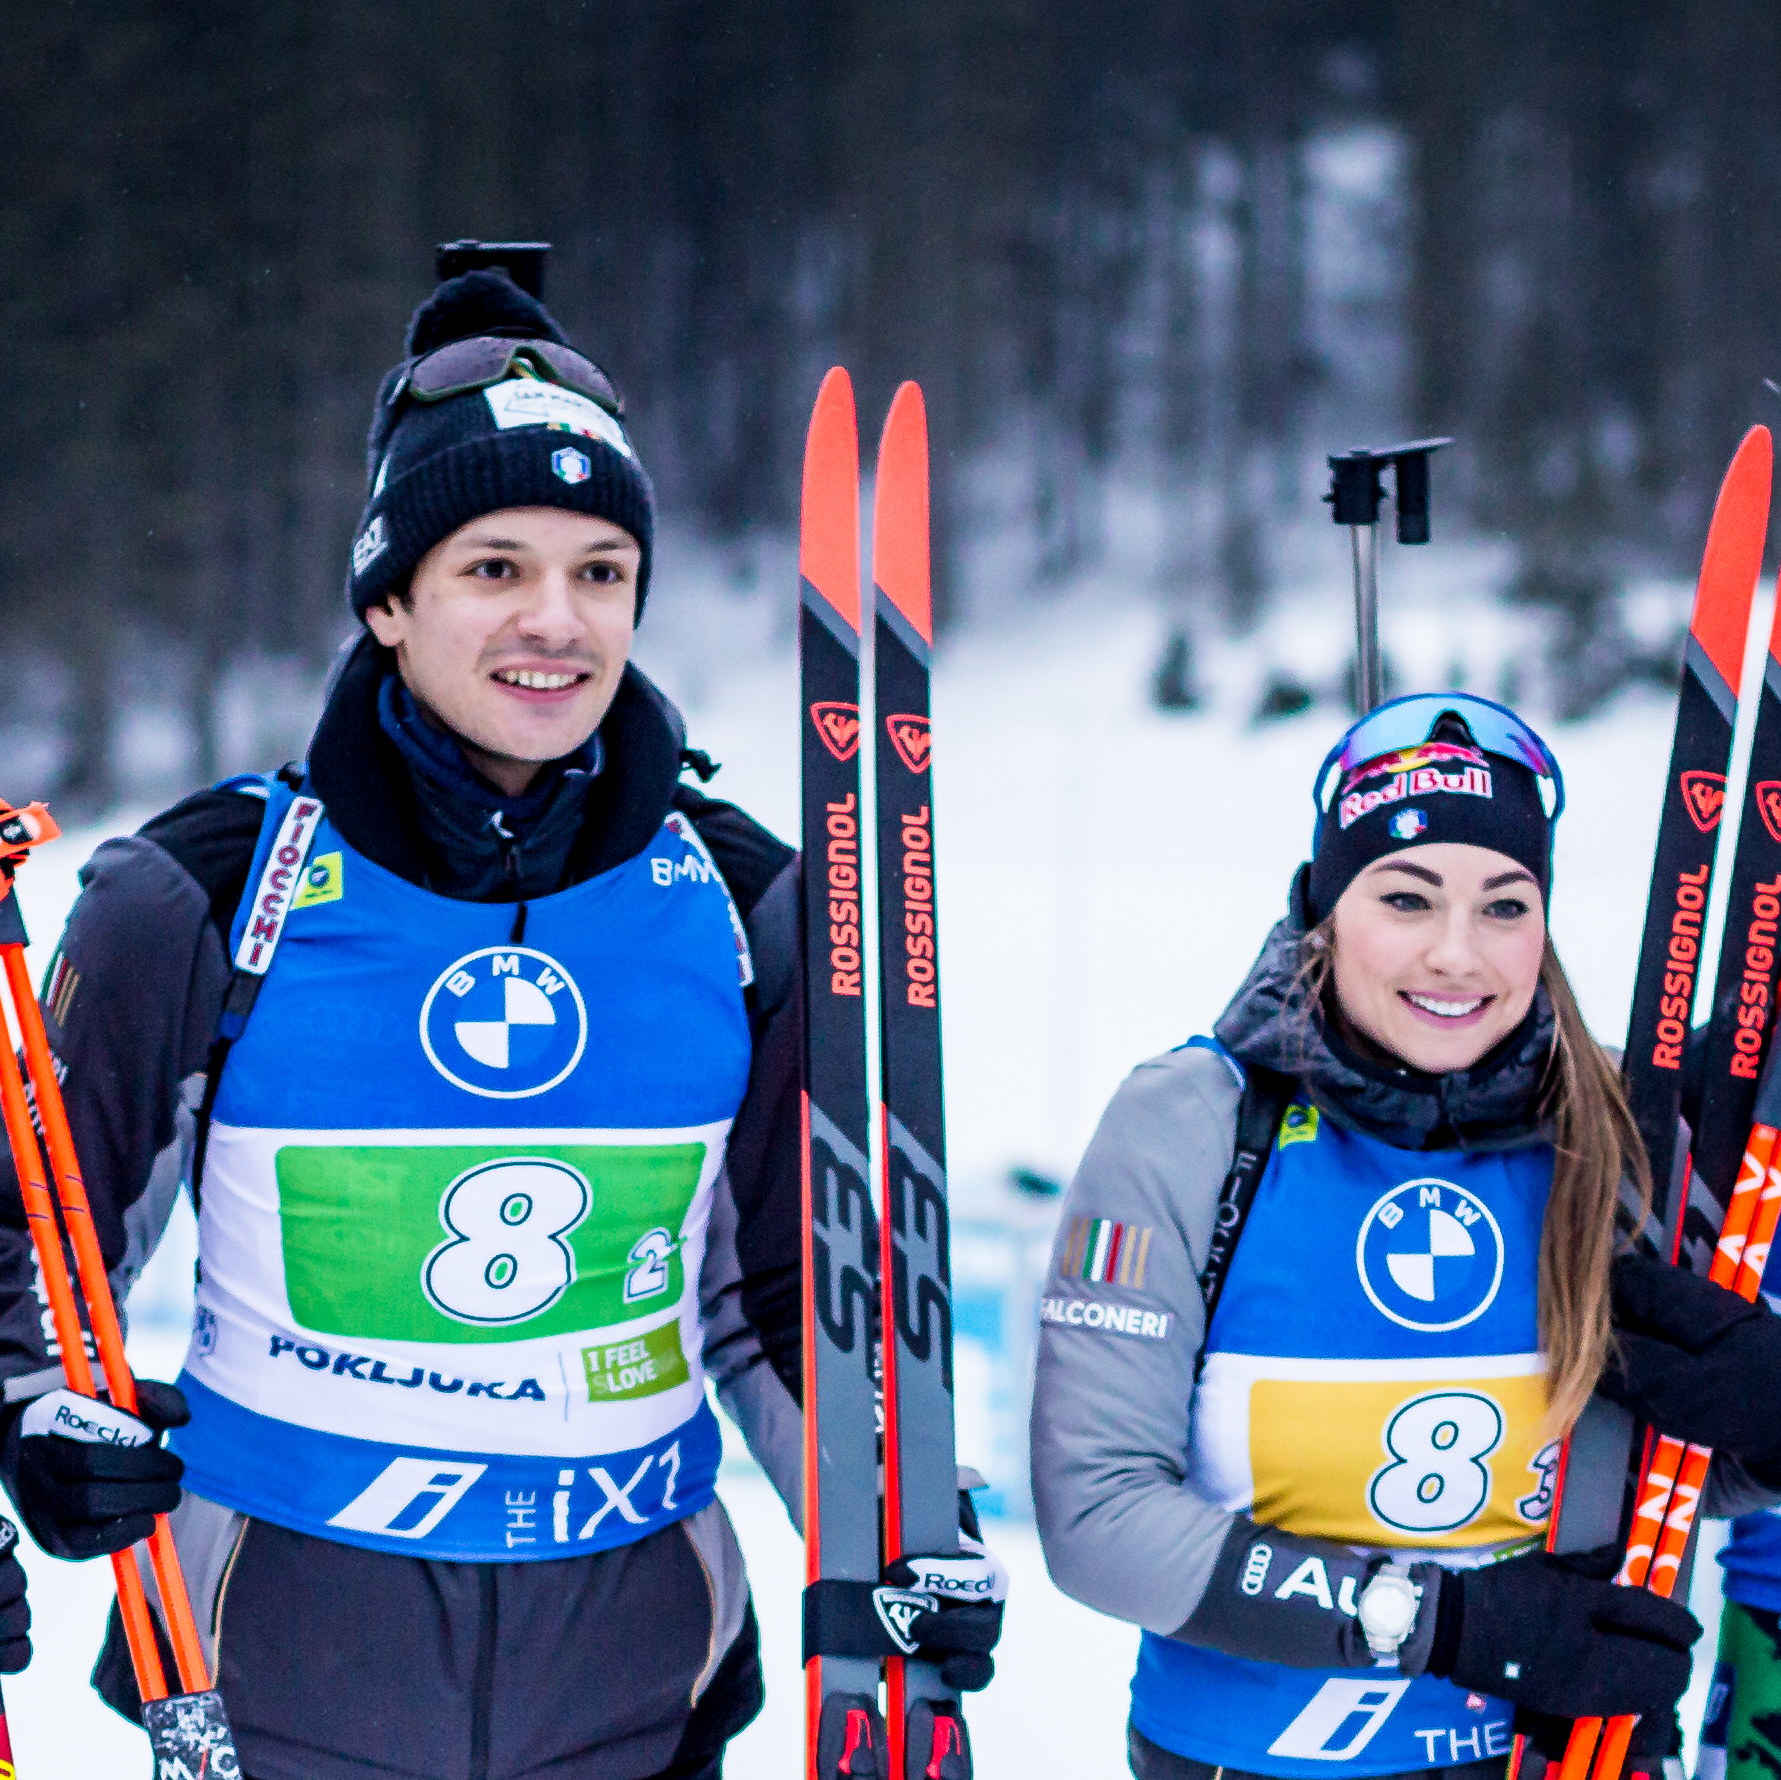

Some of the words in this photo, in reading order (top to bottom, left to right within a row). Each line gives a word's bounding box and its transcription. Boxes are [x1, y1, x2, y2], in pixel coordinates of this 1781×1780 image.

[1339, 772, 1407, 830] Red
[1409, 766, 1493, 799] Bull
[248, 803, 318, 967] FIOCCHI
[826, 792, 861, 996] ROSSIGNOL
[901, 805, 936, 1008] ROSSIGNOL
[447, 954, 567, 998] BMW
[1652, 864, 1709, 1070] ROSSIGNOL
[423, 1156, 591, 1326] 8
[623, 1229, 677, 1304] 2
[1378, 1186, 1482, 1230] BMW
[268, 1334, 546, 1401] POKLJUKA
[604, 1340, 651, 1366] FEEL
[1370, 1390, 1504, 1533] 8
[505, 1488, 537, 1549] THE
[1415, 1722, 1514, 1764] THE
